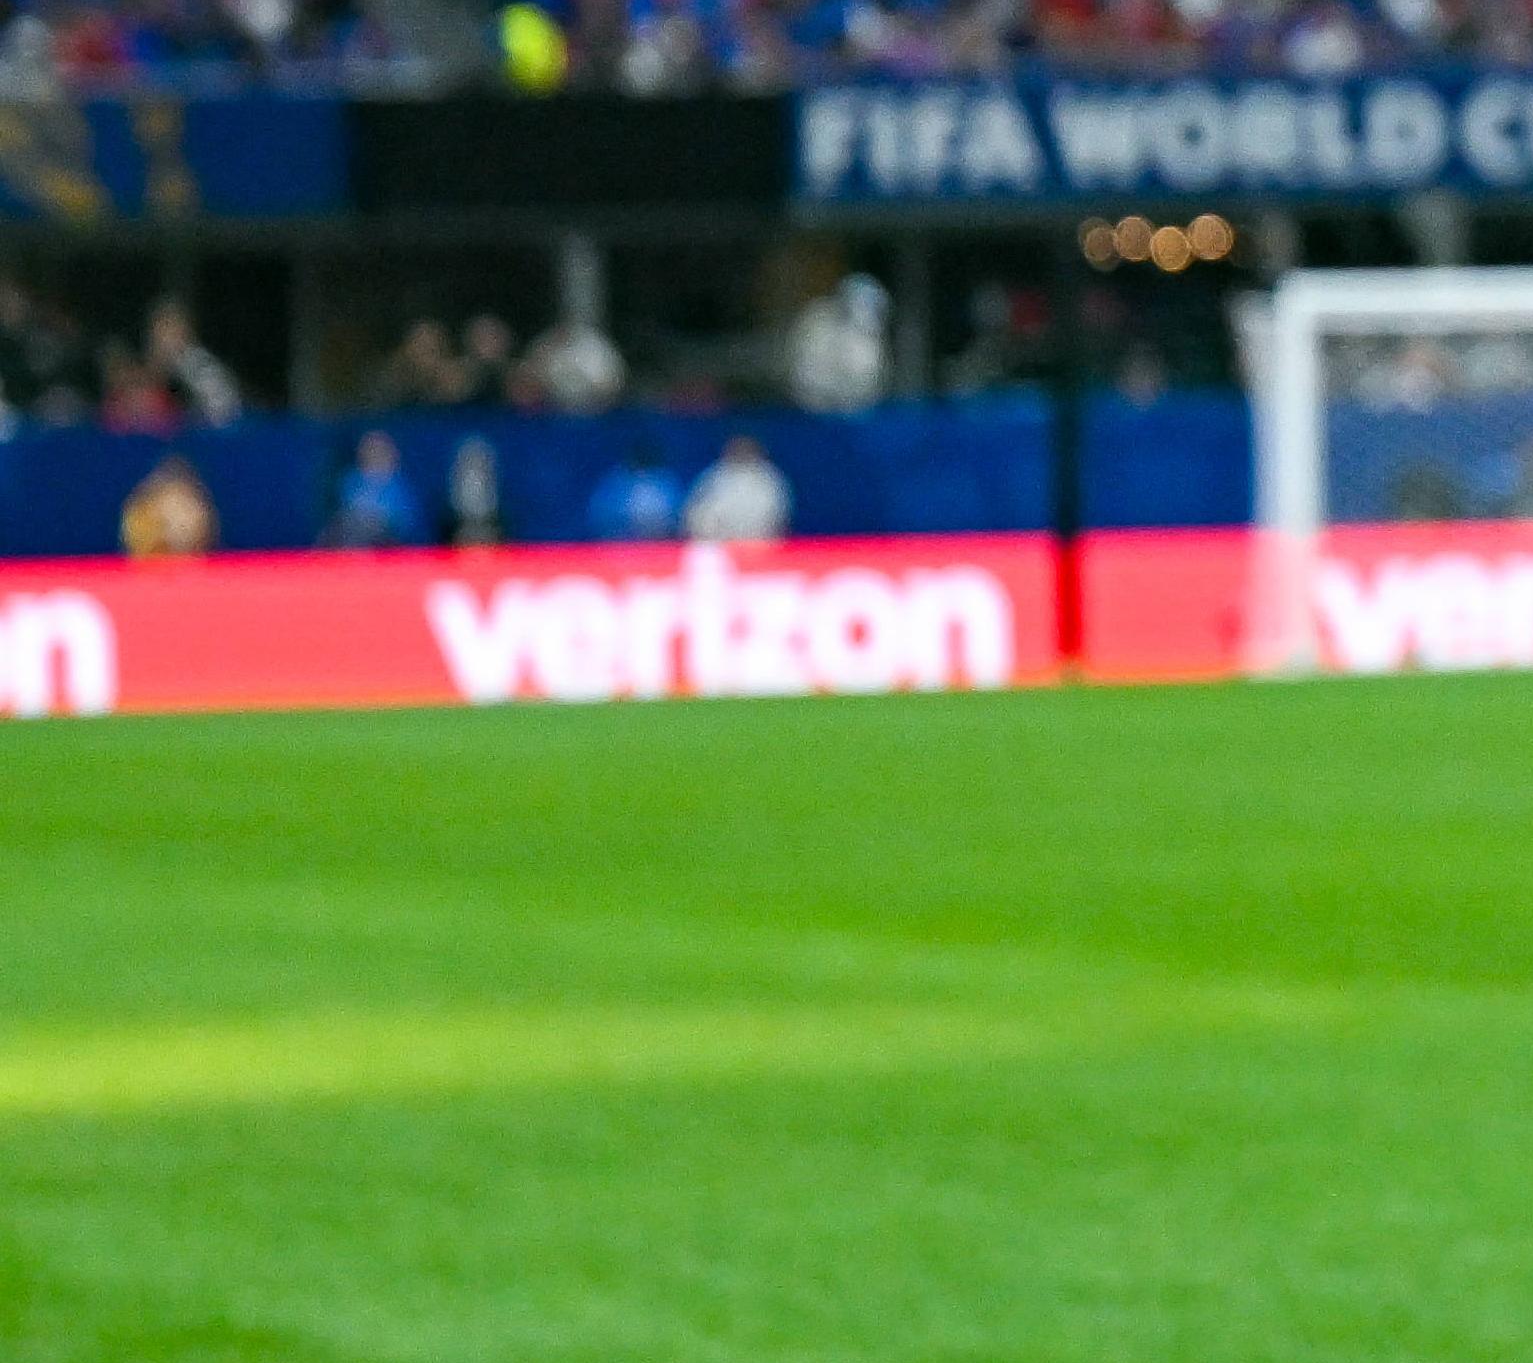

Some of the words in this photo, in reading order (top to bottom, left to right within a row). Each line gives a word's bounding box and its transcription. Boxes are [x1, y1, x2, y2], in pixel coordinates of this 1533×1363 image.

[803, 83, 1041, 196] FIFA
[1048, 81, 1450, 191] WORLD
[424, 543, 1016, 704] verizon
